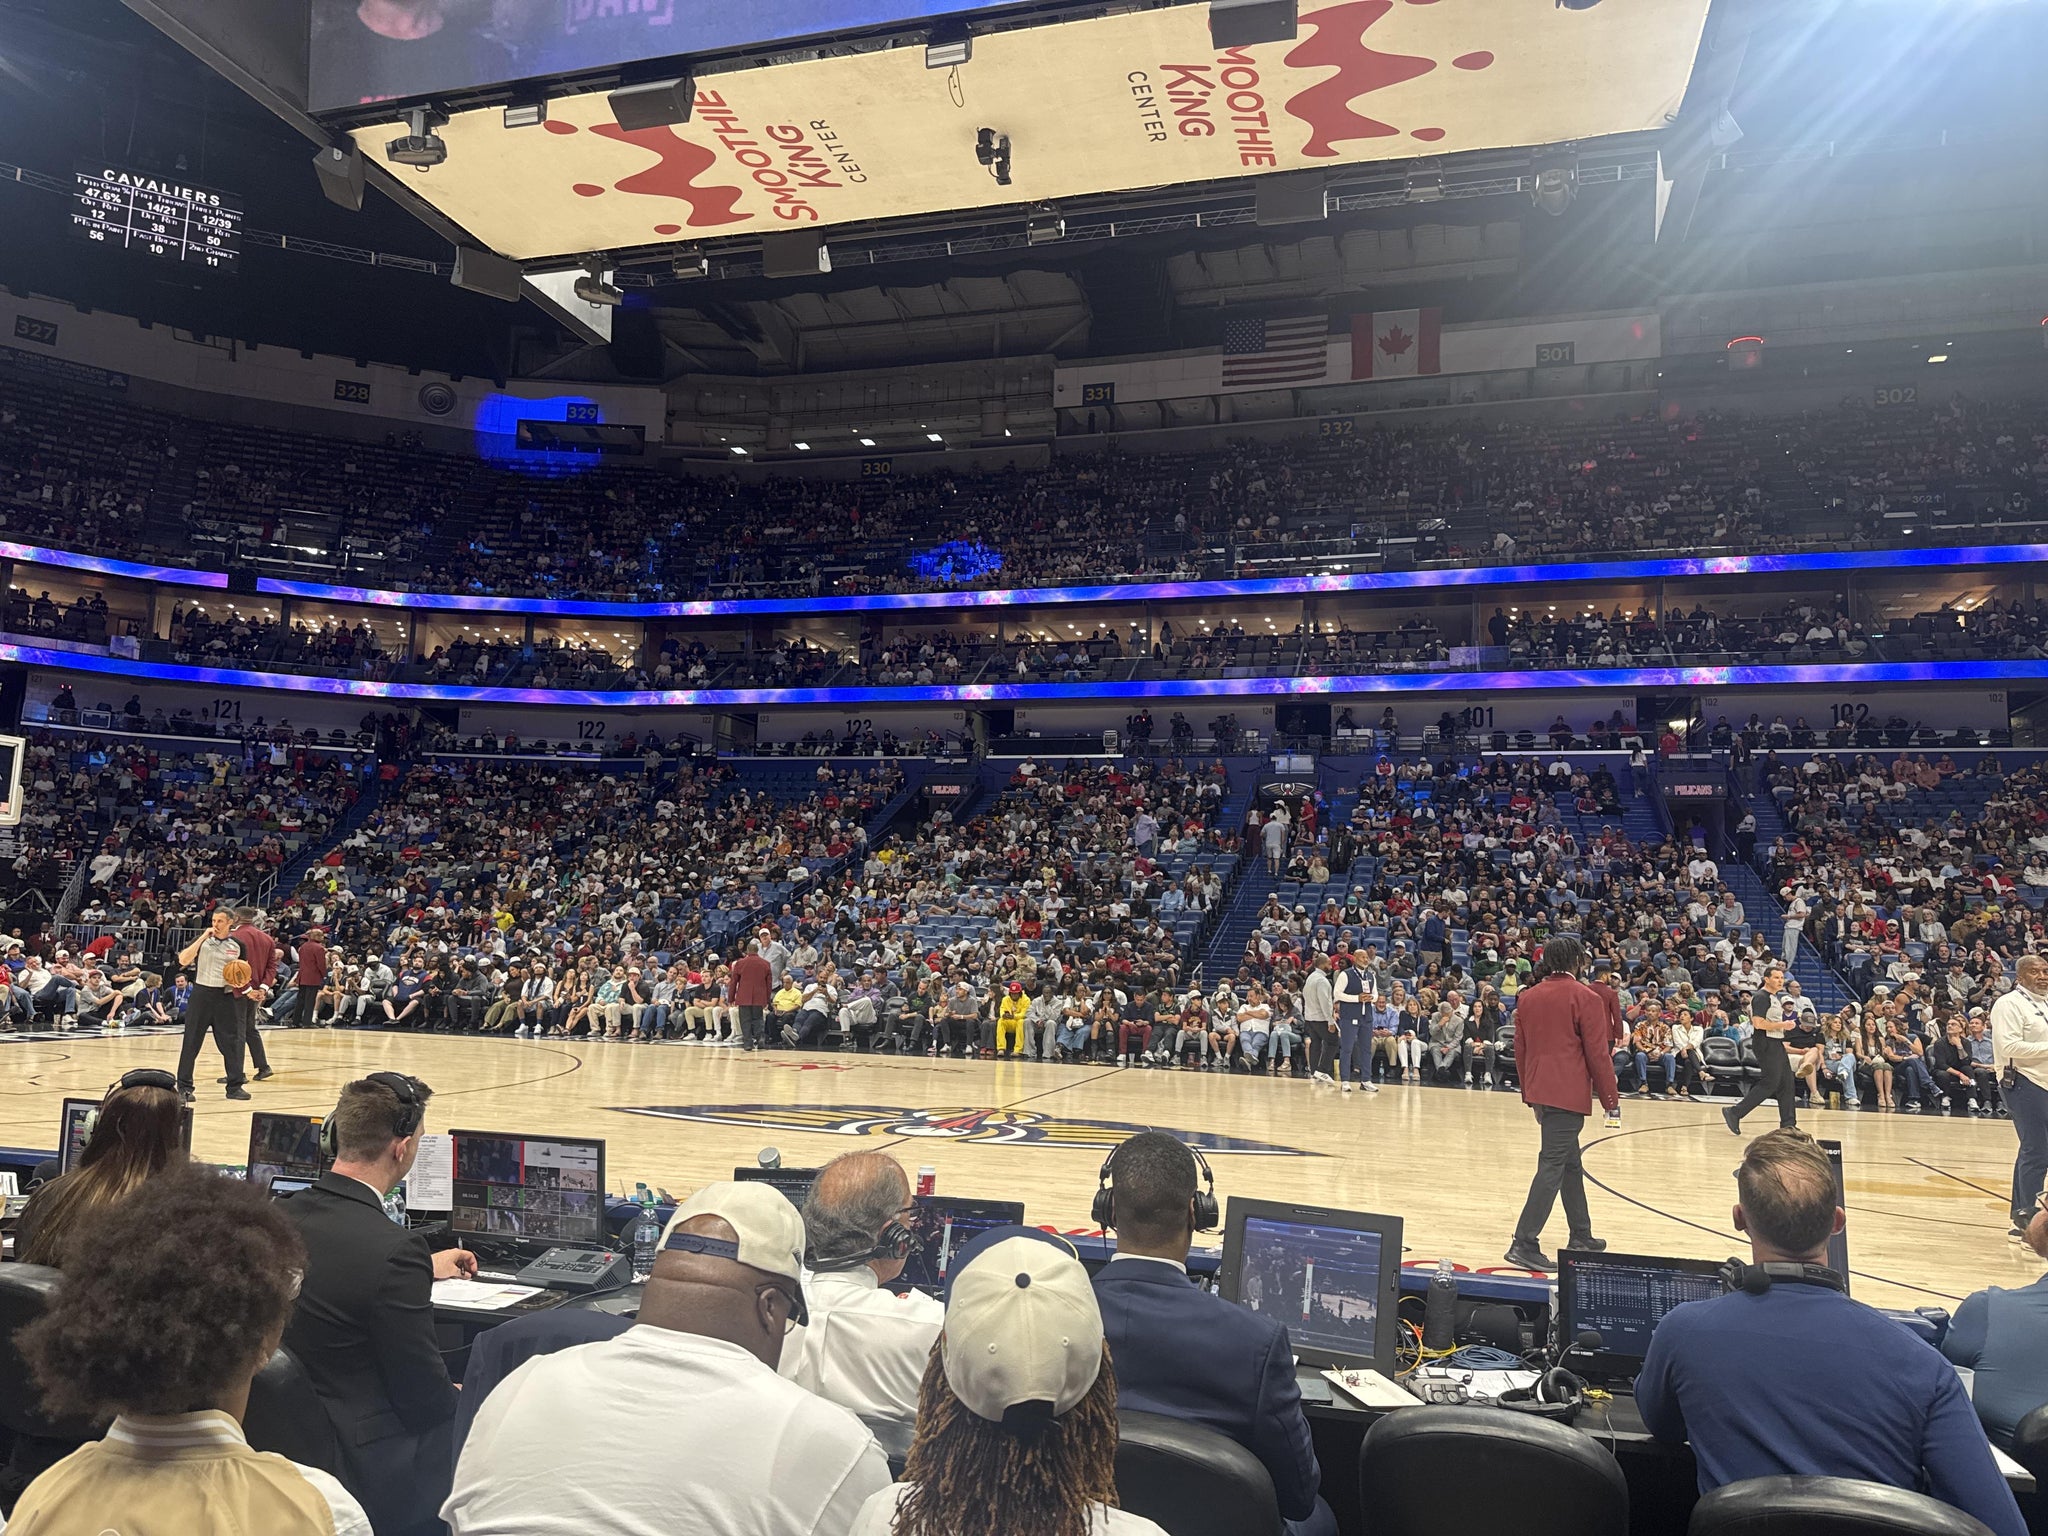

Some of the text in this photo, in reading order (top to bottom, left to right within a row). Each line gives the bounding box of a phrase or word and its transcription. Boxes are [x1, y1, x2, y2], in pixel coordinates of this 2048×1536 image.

[1128, 71, 1167, 142] CENTER
[1217, 45, 1276, 166] MOOTHIE
[693, 90, 818, 221] SMOOTHIE
[810, 119, 867, 183] CENTER
[103, 169, 220, 206] CAVALIERS
[85, 187, 122, 203] 47.6%
[91, 209, 106, 220] 12
[146, 202, 177, 216] 14/21
[151, 222, 165, 234] 38
[202, 215, 232, 229] 12/39
[89, 230, 104, 241] 56
[207, 235, 221, 246] 50
[150, 243, 164, 255] 10
[206, 256, 218, 267] 11
[17, 319, 56, 340] 327
[1540, 347, 1570, 362] 301
[335, 384, 370, 400] 328
[1086, 386, 1111, 400] 331
[1876, 387, 1916, 405] 302
[568, 406, 597, 419] 329
[1321, 421, 1353, 436] 332
[863, 461, 891, 475] 330
[1622, 699, 1634, 708] 101
[1705, 697, 1718, 706] 102
[1989, 693, 2003, 702] 102
[213, 699, 241, 720] 121
[461, 710, 472, 719] 122
[954, 712, 964, 720] 123
[1830, 703, 1869, 727] 102
[702, 716, 711, 724] 122
[577, 720, 606, 740] 122
[931, 785, 961, 795] PELICANS
[1674, 784, 1713, 796] PELICANS
